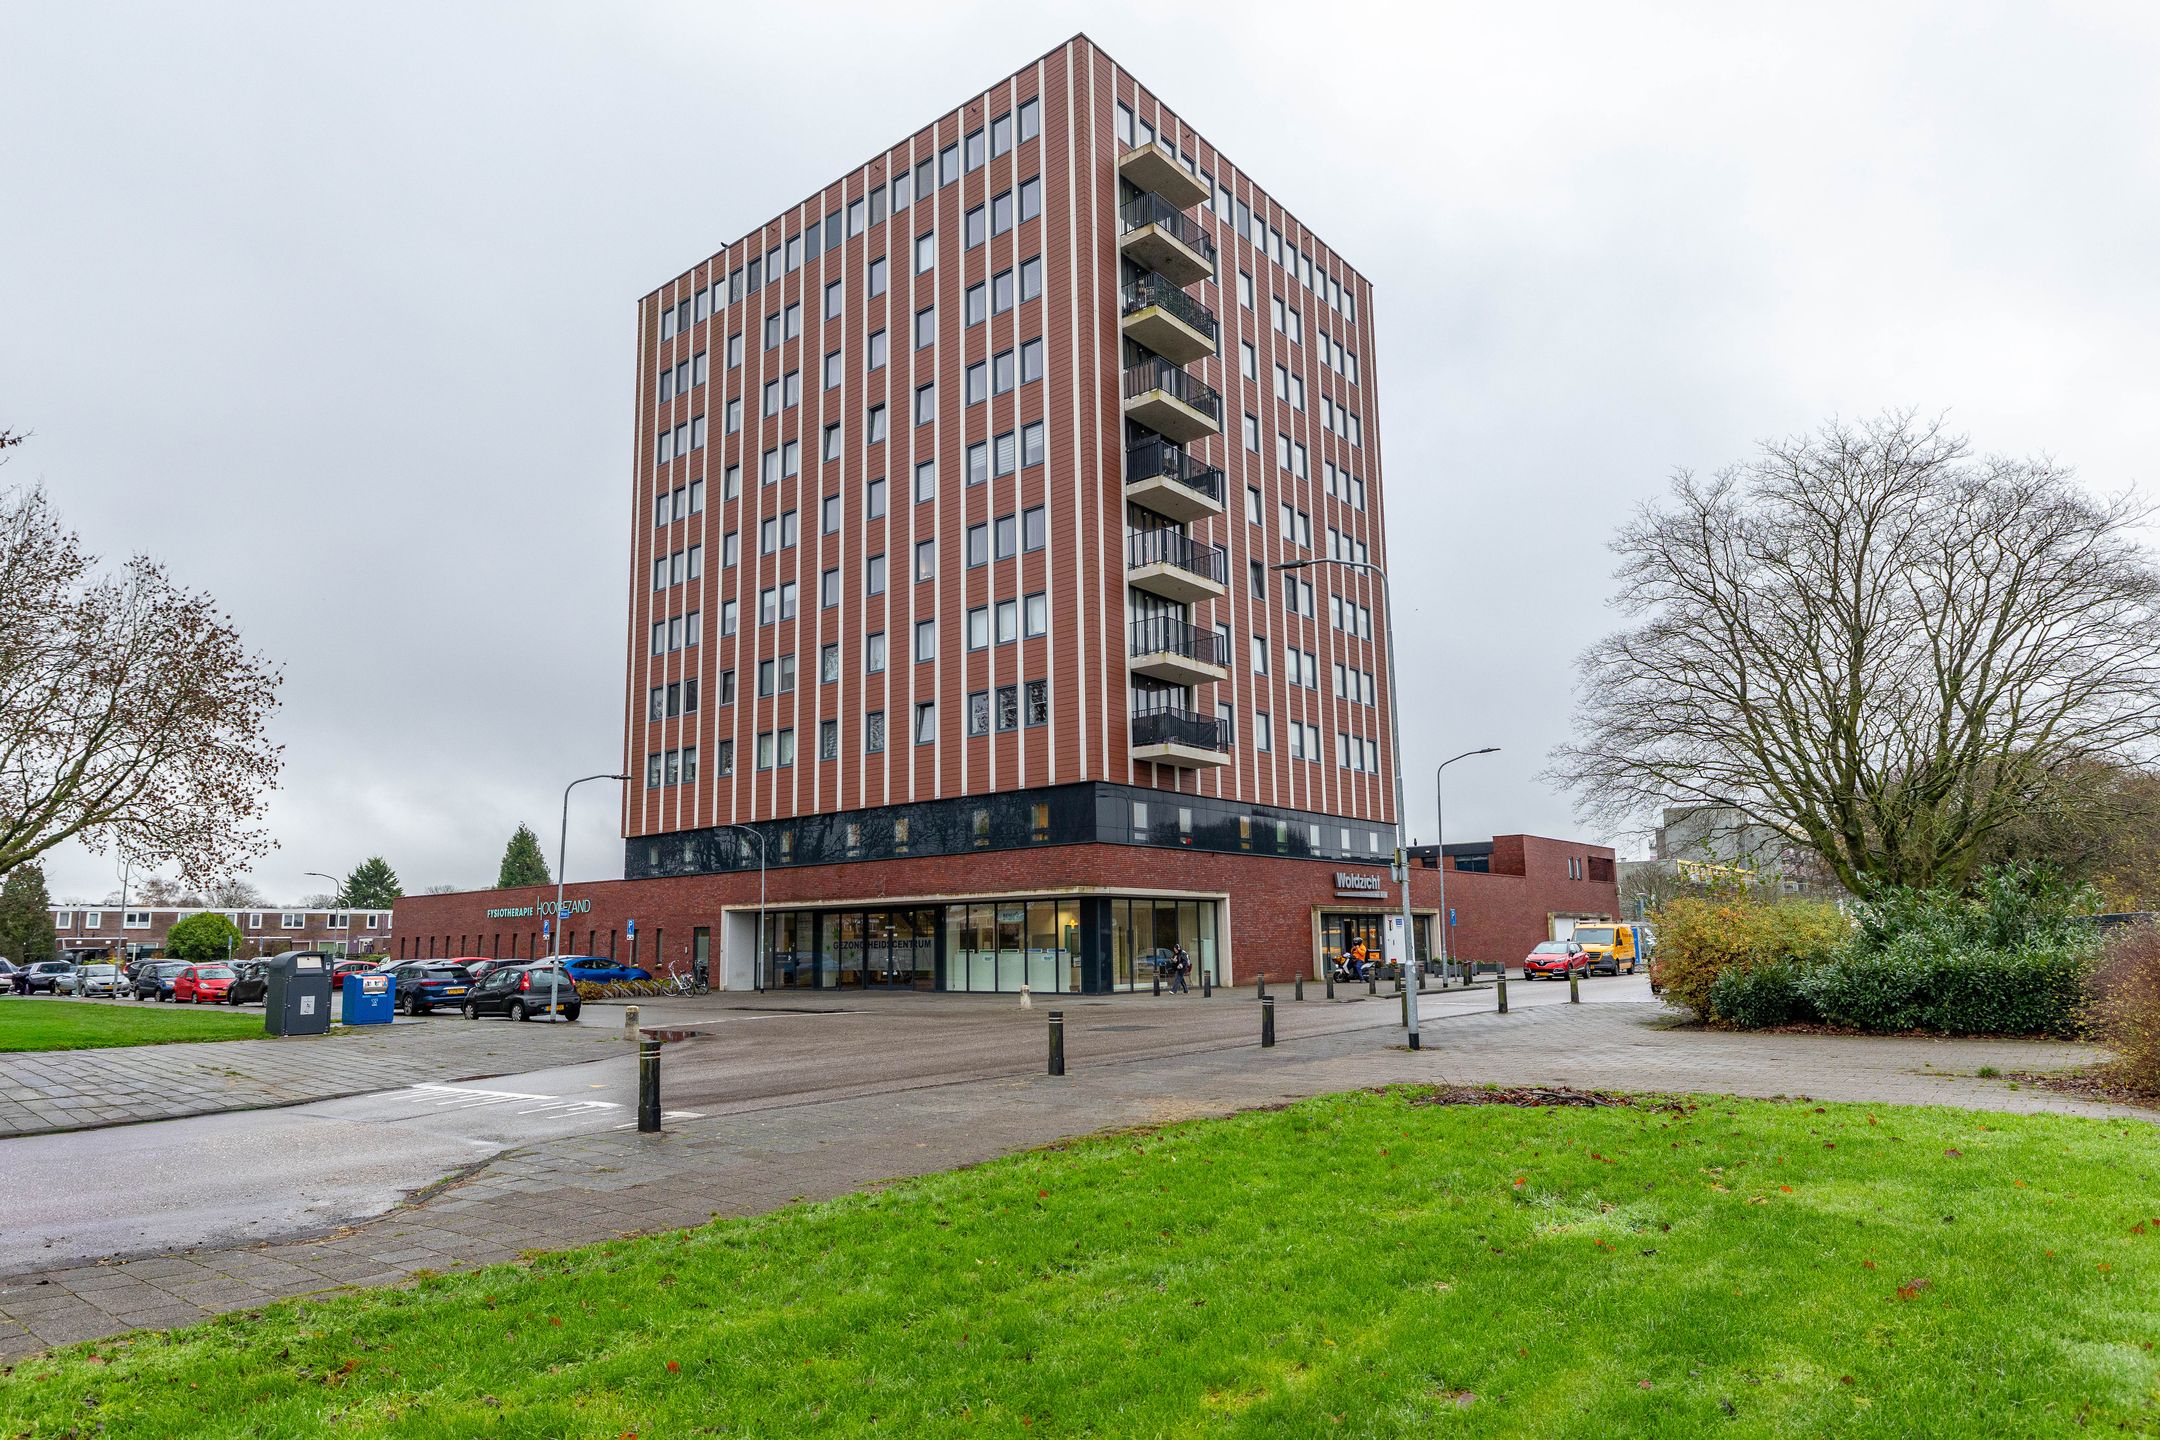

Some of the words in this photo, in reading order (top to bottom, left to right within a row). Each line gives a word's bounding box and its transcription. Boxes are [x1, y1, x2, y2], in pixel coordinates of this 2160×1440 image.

[1335, 872, 1380, 889] Woldzicht
[487, 907, 533, 918] FYSIOTHERAPIE
[833, 940, 932, 949] GEZONDHEIDCENTRUM
